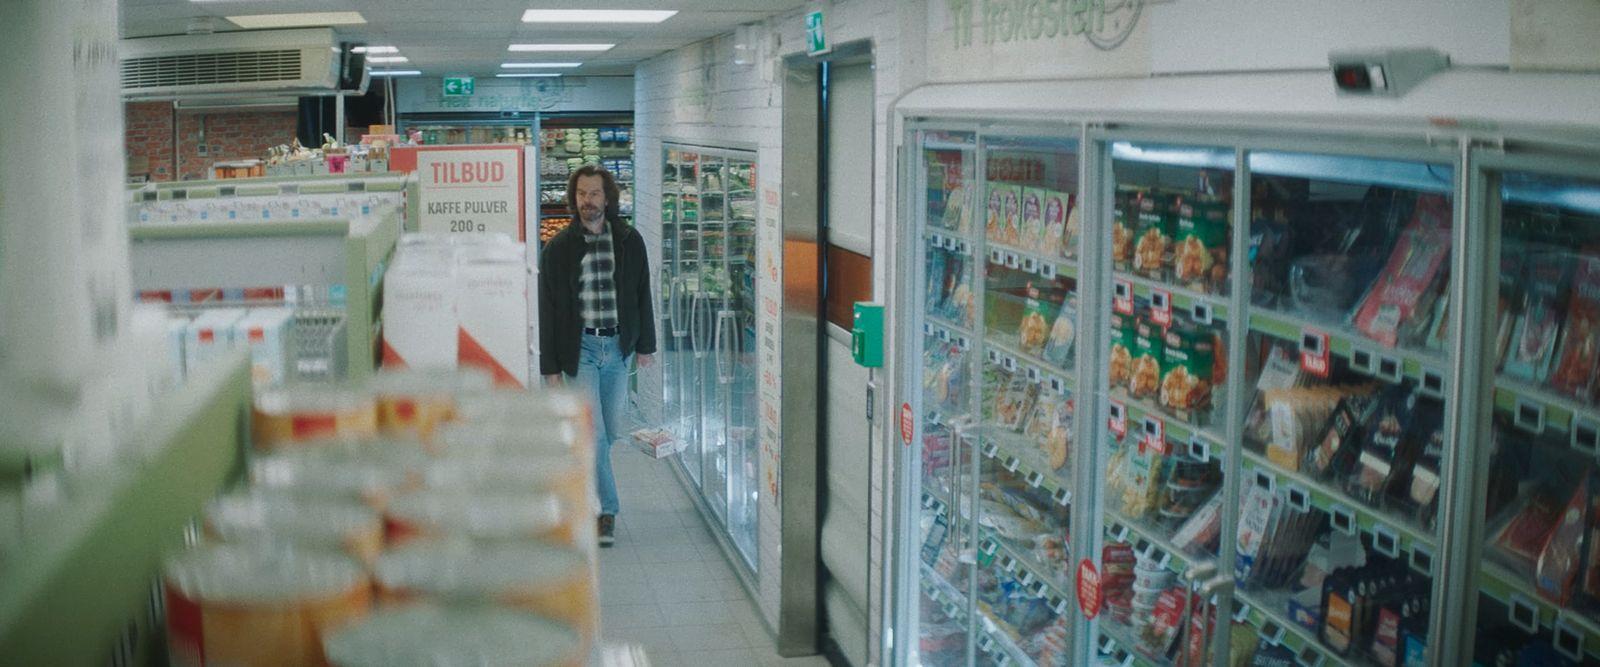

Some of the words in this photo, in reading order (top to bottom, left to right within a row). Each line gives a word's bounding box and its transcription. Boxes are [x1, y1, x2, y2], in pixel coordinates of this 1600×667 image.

[430, 161, 505, 184] TILBUD
[427, 202, 462, 215] KAFFE
[464, 200, 508, 214] PULVER
[450, 219, 474, 232] 200
